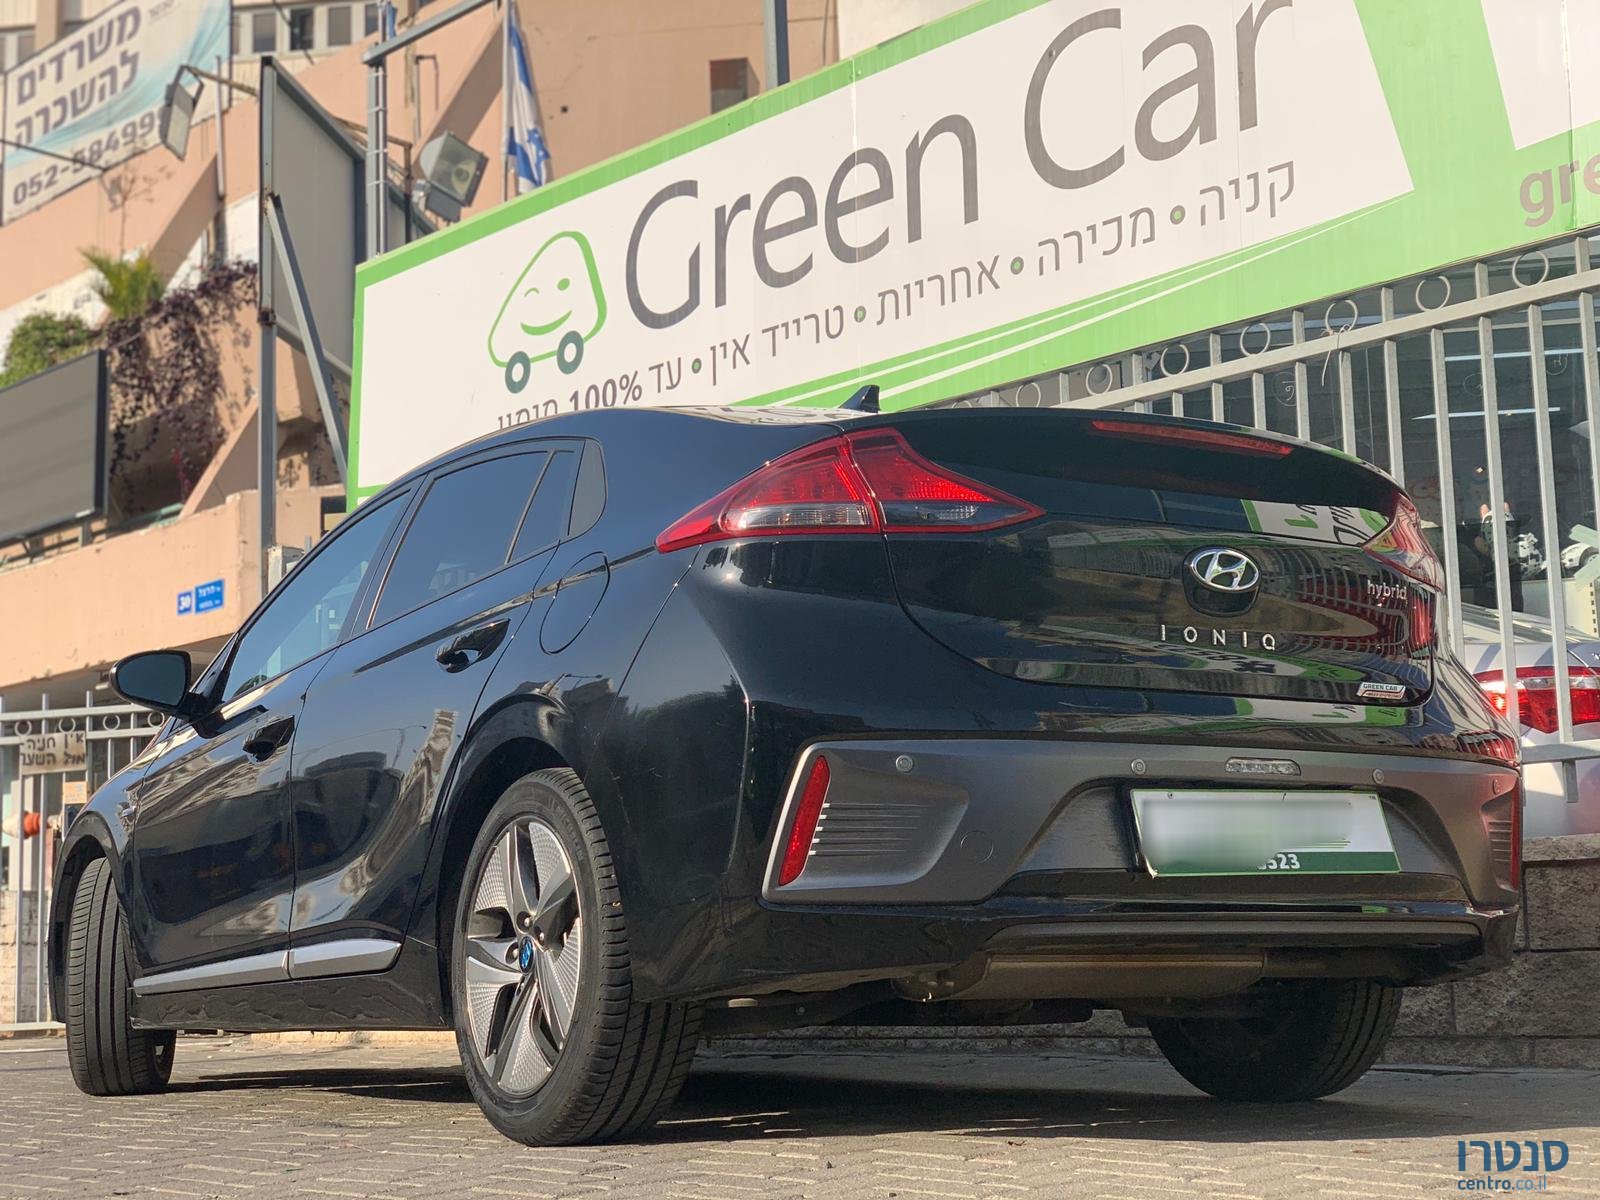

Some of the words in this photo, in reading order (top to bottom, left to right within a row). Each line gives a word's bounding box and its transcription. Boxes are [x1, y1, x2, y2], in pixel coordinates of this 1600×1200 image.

[18, 6, 141, 106] משרדים
[16, 50, 140, 148] להשכרה
[13, 106, 165, 205] 052-58499
[625, 114, 980, 329] Green
[1023, 0, 1293, 190] Car
[1200, 161, 1295, 226] קניה
[1038, 207, 1155, 276] מכירה
[876, 255, 1000, 325] אחריות
[710, 333, 751, 386] אין
[762, 305, 844, 357] טרייד
[569, 370, 642, 411] 100%
[648, 357, 682, 393] עד
[1367, 580, 1407, 600] hybrid
[1161, 624, 1276, 651] IONIQ
[64, 732, 84, 749] אין
